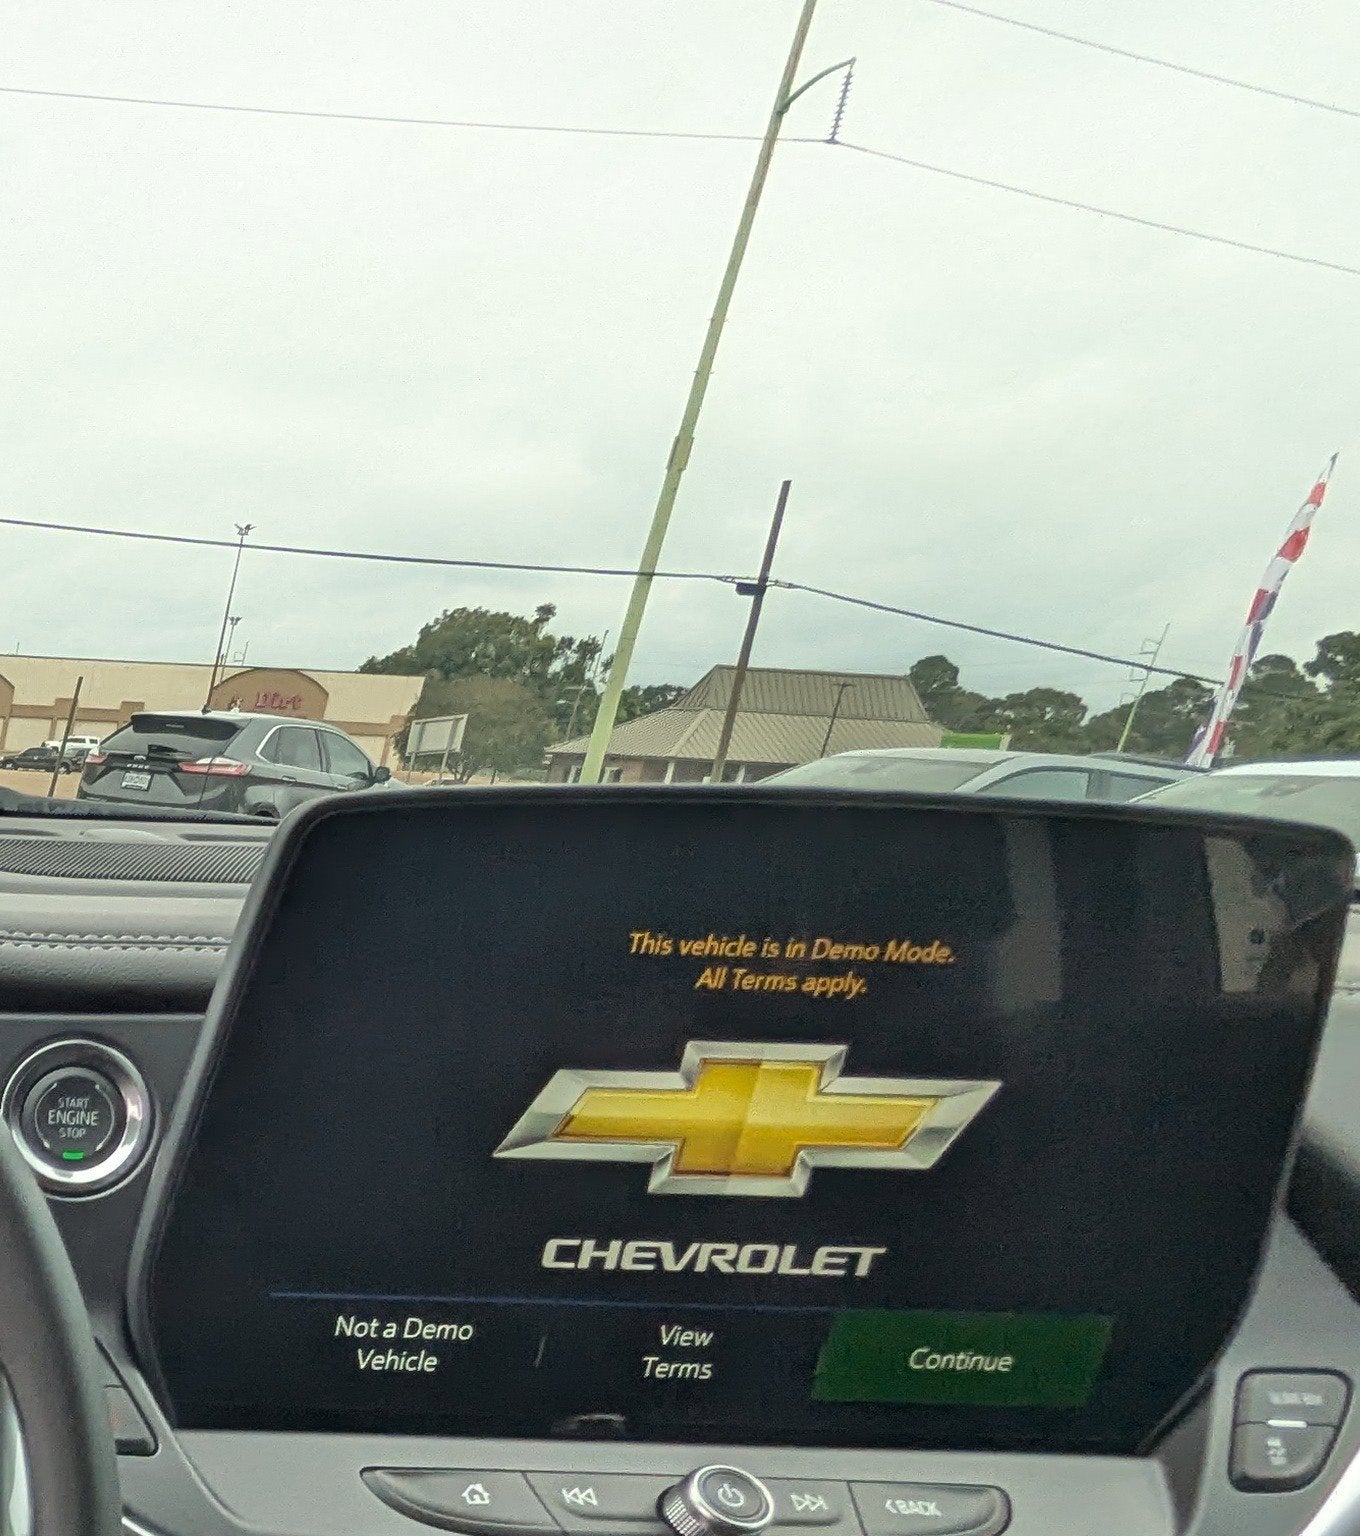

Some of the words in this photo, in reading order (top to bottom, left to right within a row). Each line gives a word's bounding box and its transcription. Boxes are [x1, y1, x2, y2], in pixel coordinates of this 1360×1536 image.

[629, 932, 673, 955] This
[679, 934, 755, 958] vehicle
[761, 938, 779, 958] is
[785, 938, 805, 959] in
[811, 939, 878, 961] Demo
[884, 941, 956, 964] Mode.
[694, 968, 726, 990] All
[732, 969, 796, 992] Terms
[801, 972, 867, 1000] apply.
[58, 1098, 90, 1108] START
[47, 1110, 99, 1126] ENGINE
[58, 1128, 87, 1138] STOP
[540, 1238, 886, 1278] CHEVROLET
[334, 1316, 379, 1341] Not
[383, 1325, 397, 1342] a
[402, 1317, 474, 1343] Demo
[659, 1325, 714, 1350] View
[356, 1349, 439, 1374] Vehicle
[642, 1357, 713, 1382] Terms
[908, 1348, 1014, 1373] Continue
